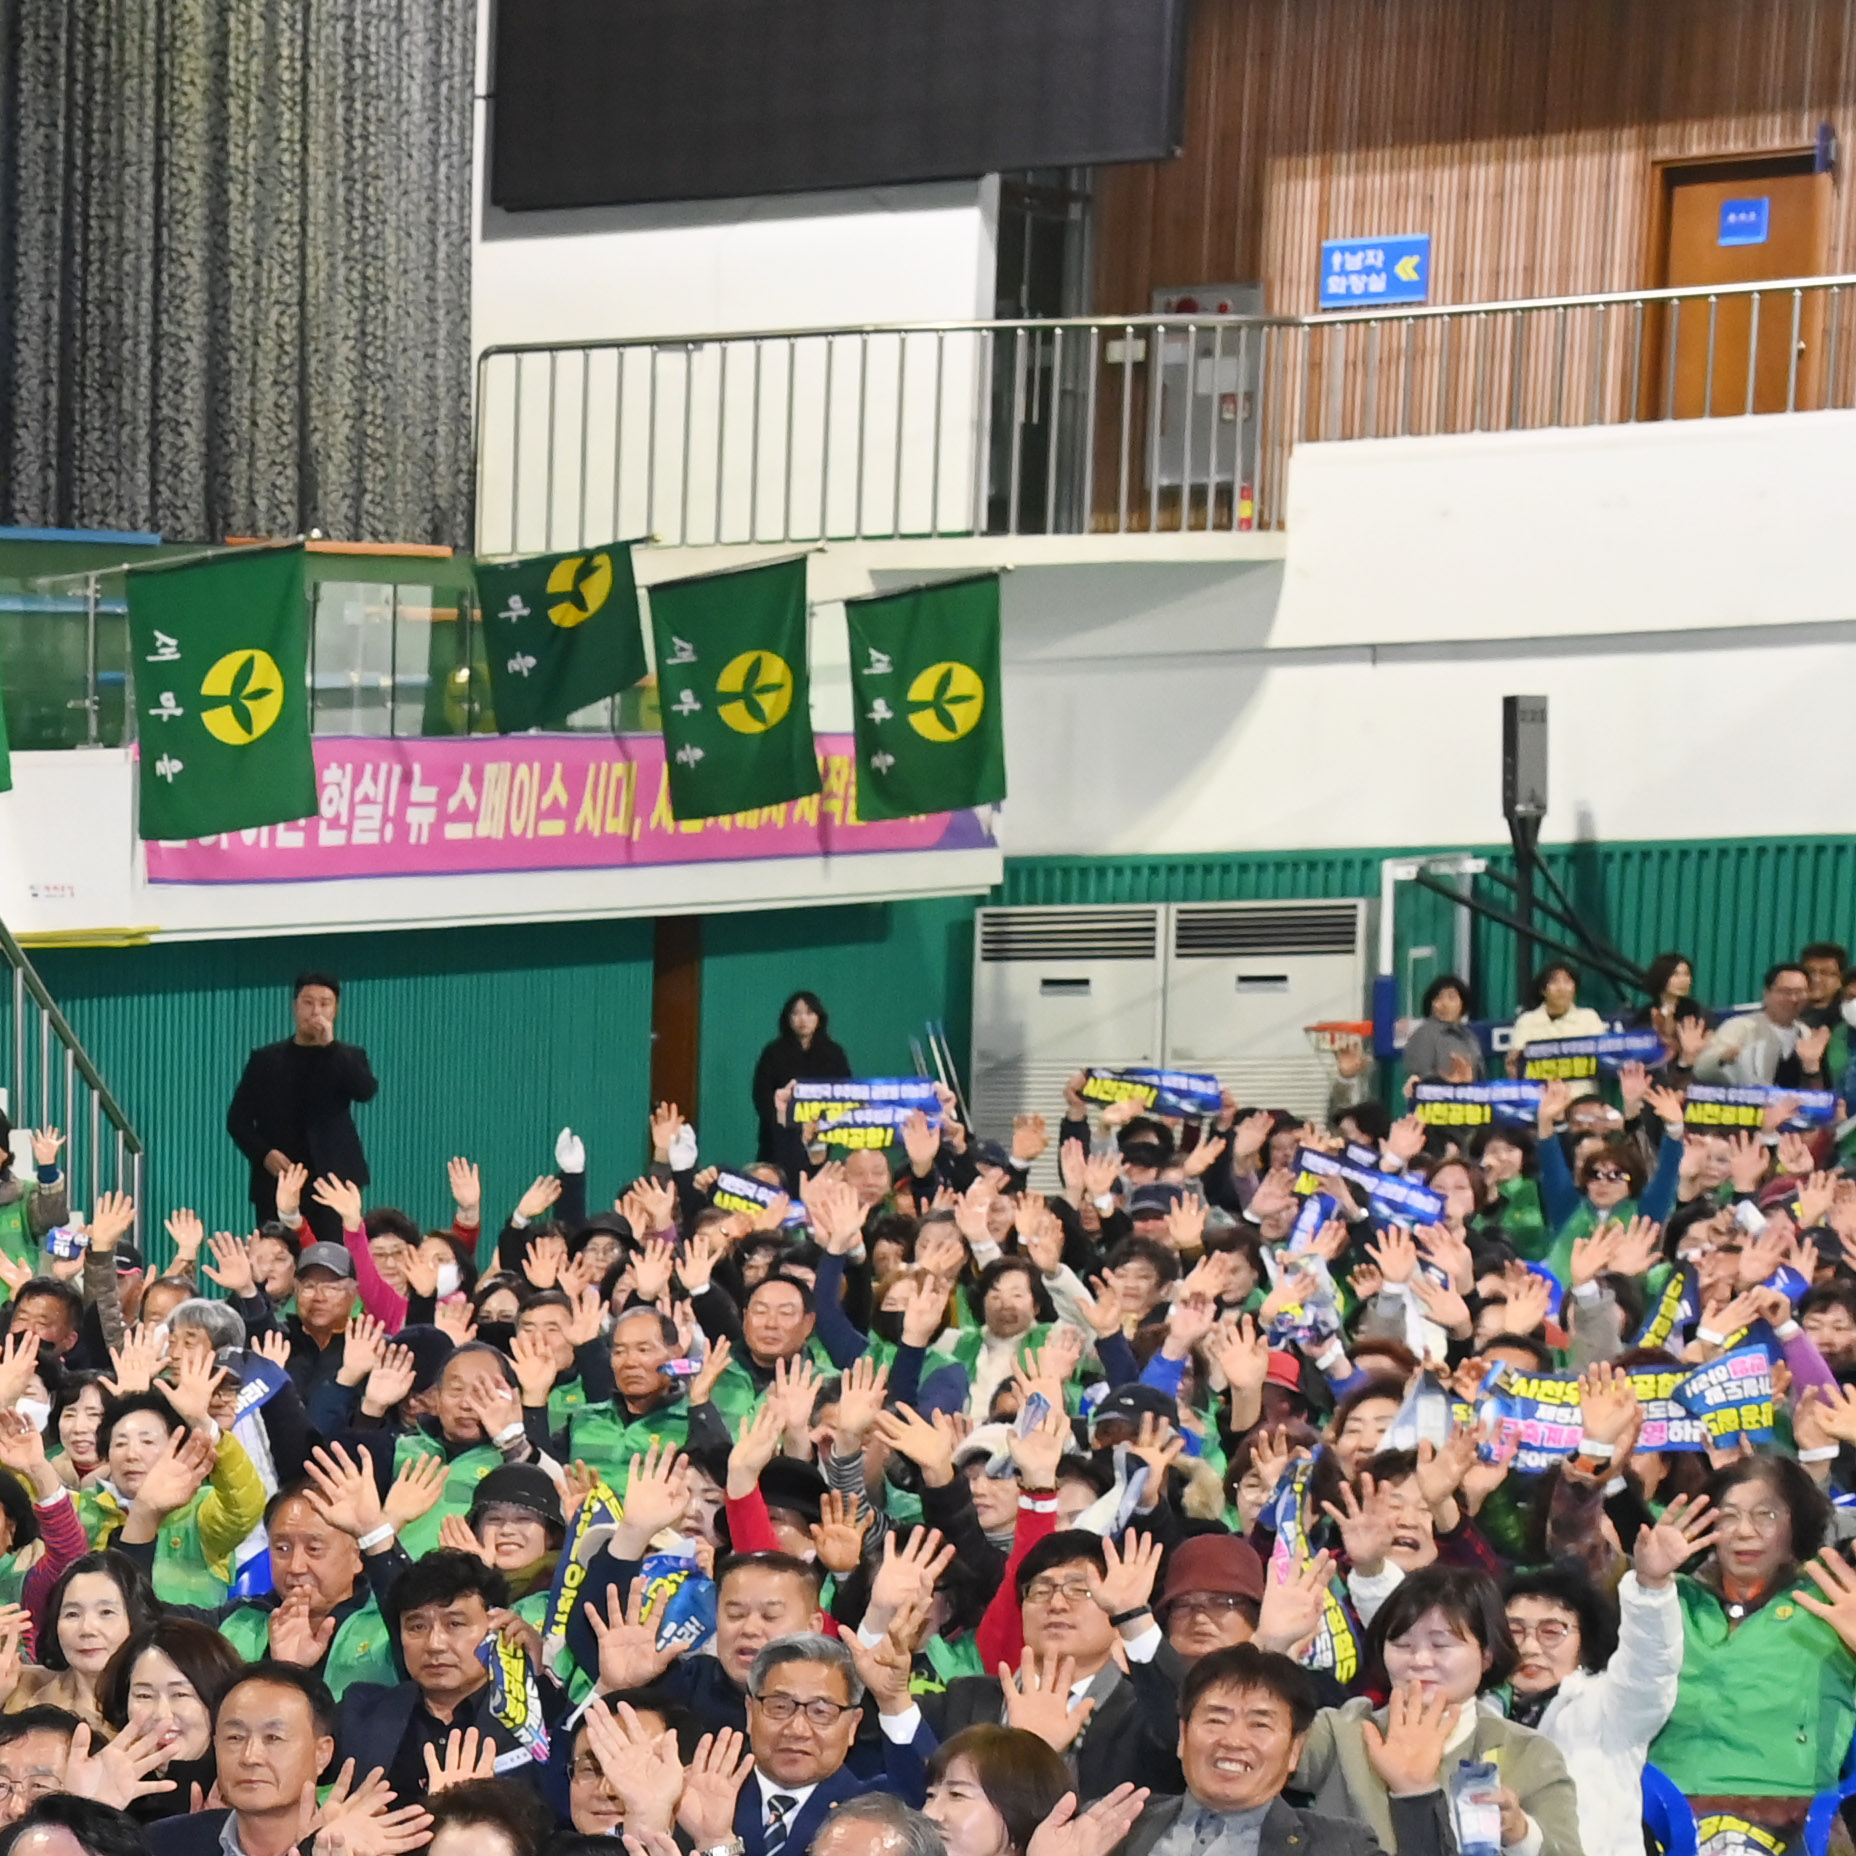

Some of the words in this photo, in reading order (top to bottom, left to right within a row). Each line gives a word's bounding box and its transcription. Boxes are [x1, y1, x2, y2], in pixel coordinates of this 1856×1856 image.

[146, 628, 183, 783] 새마을
[318, 761, 402, 847] 현실!
[405, 762, 439, 846] 뉴
[444, 761, 569, 841] 스페이스
